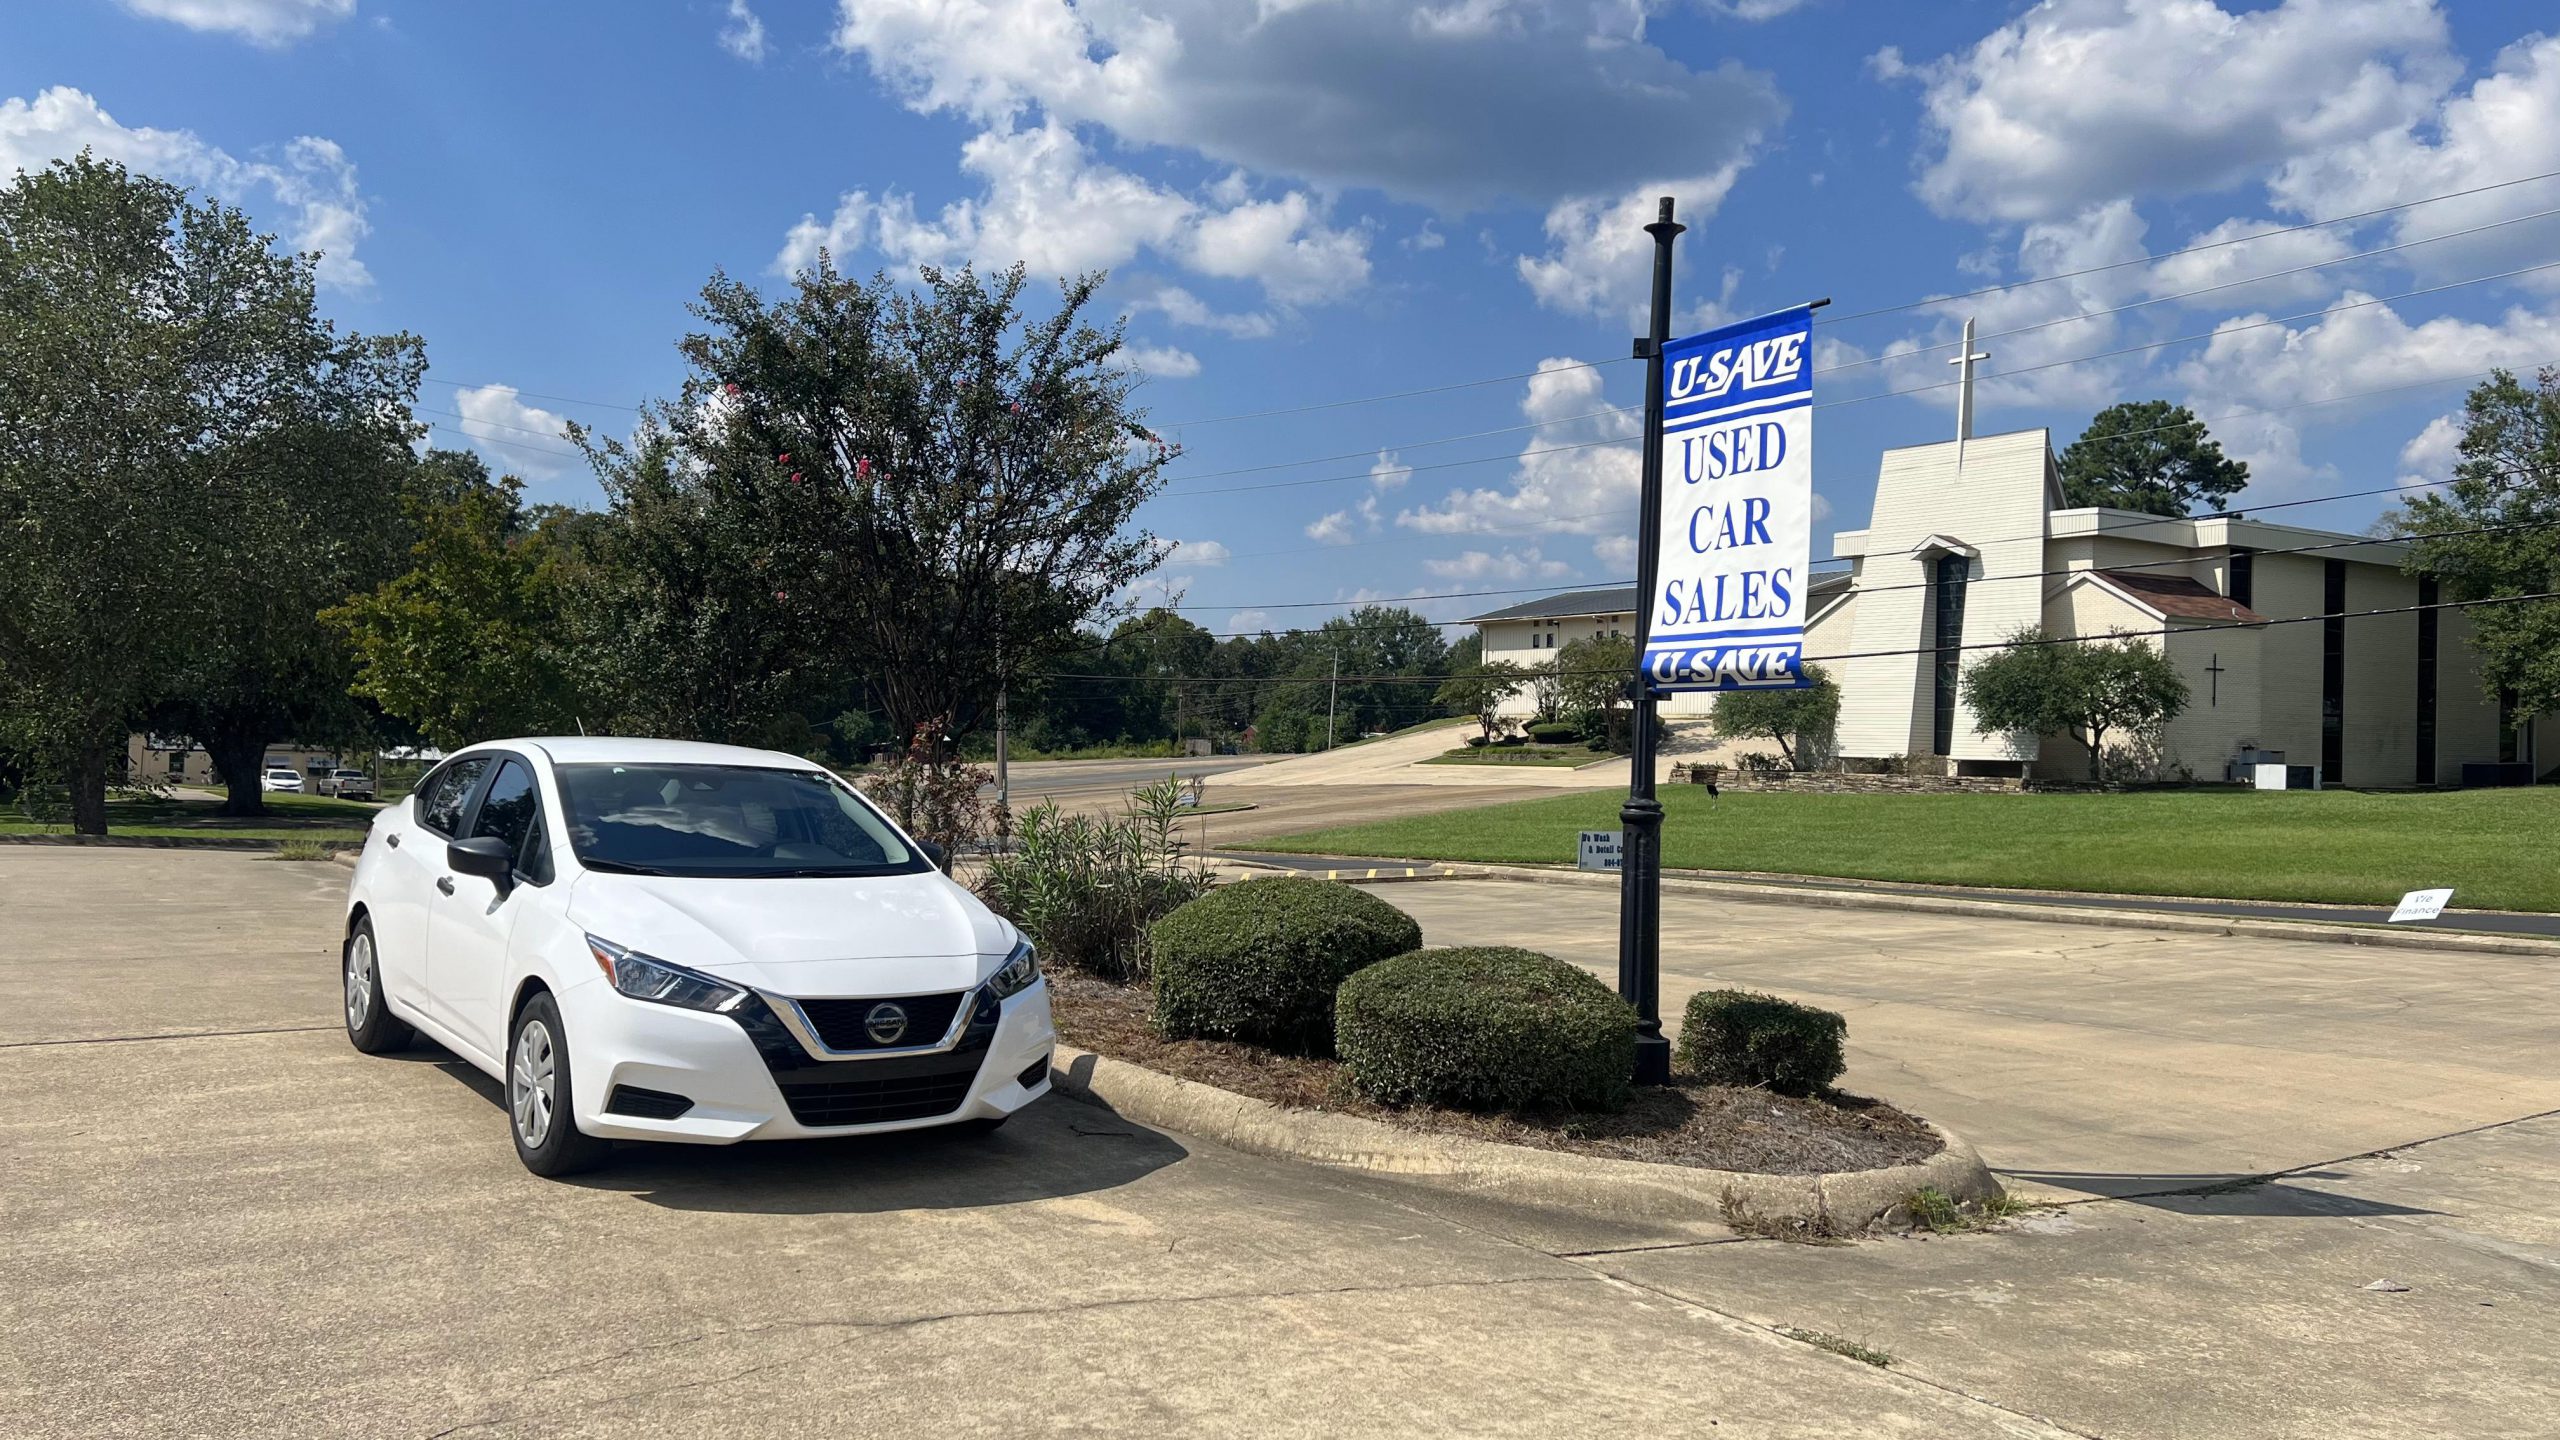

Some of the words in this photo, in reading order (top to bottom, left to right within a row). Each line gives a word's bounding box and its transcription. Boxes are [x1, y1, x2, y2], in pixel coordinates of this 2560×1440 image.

[1667, 331, 1808, 404] U-SAVE
[1682, 421, 1788, 485] USED
[1688, 497, 1774, 554] CAR
[1660, 567, 1793, 626] SALES
[1652, 645, 1798, 686] U-SAVE
[1594, 834, 1610, 842] Wash
[1596, 845, 1614, 853] Detail
[2396, 907, 2440, 916] Finance
[2415, 895, 2433, 903] We
